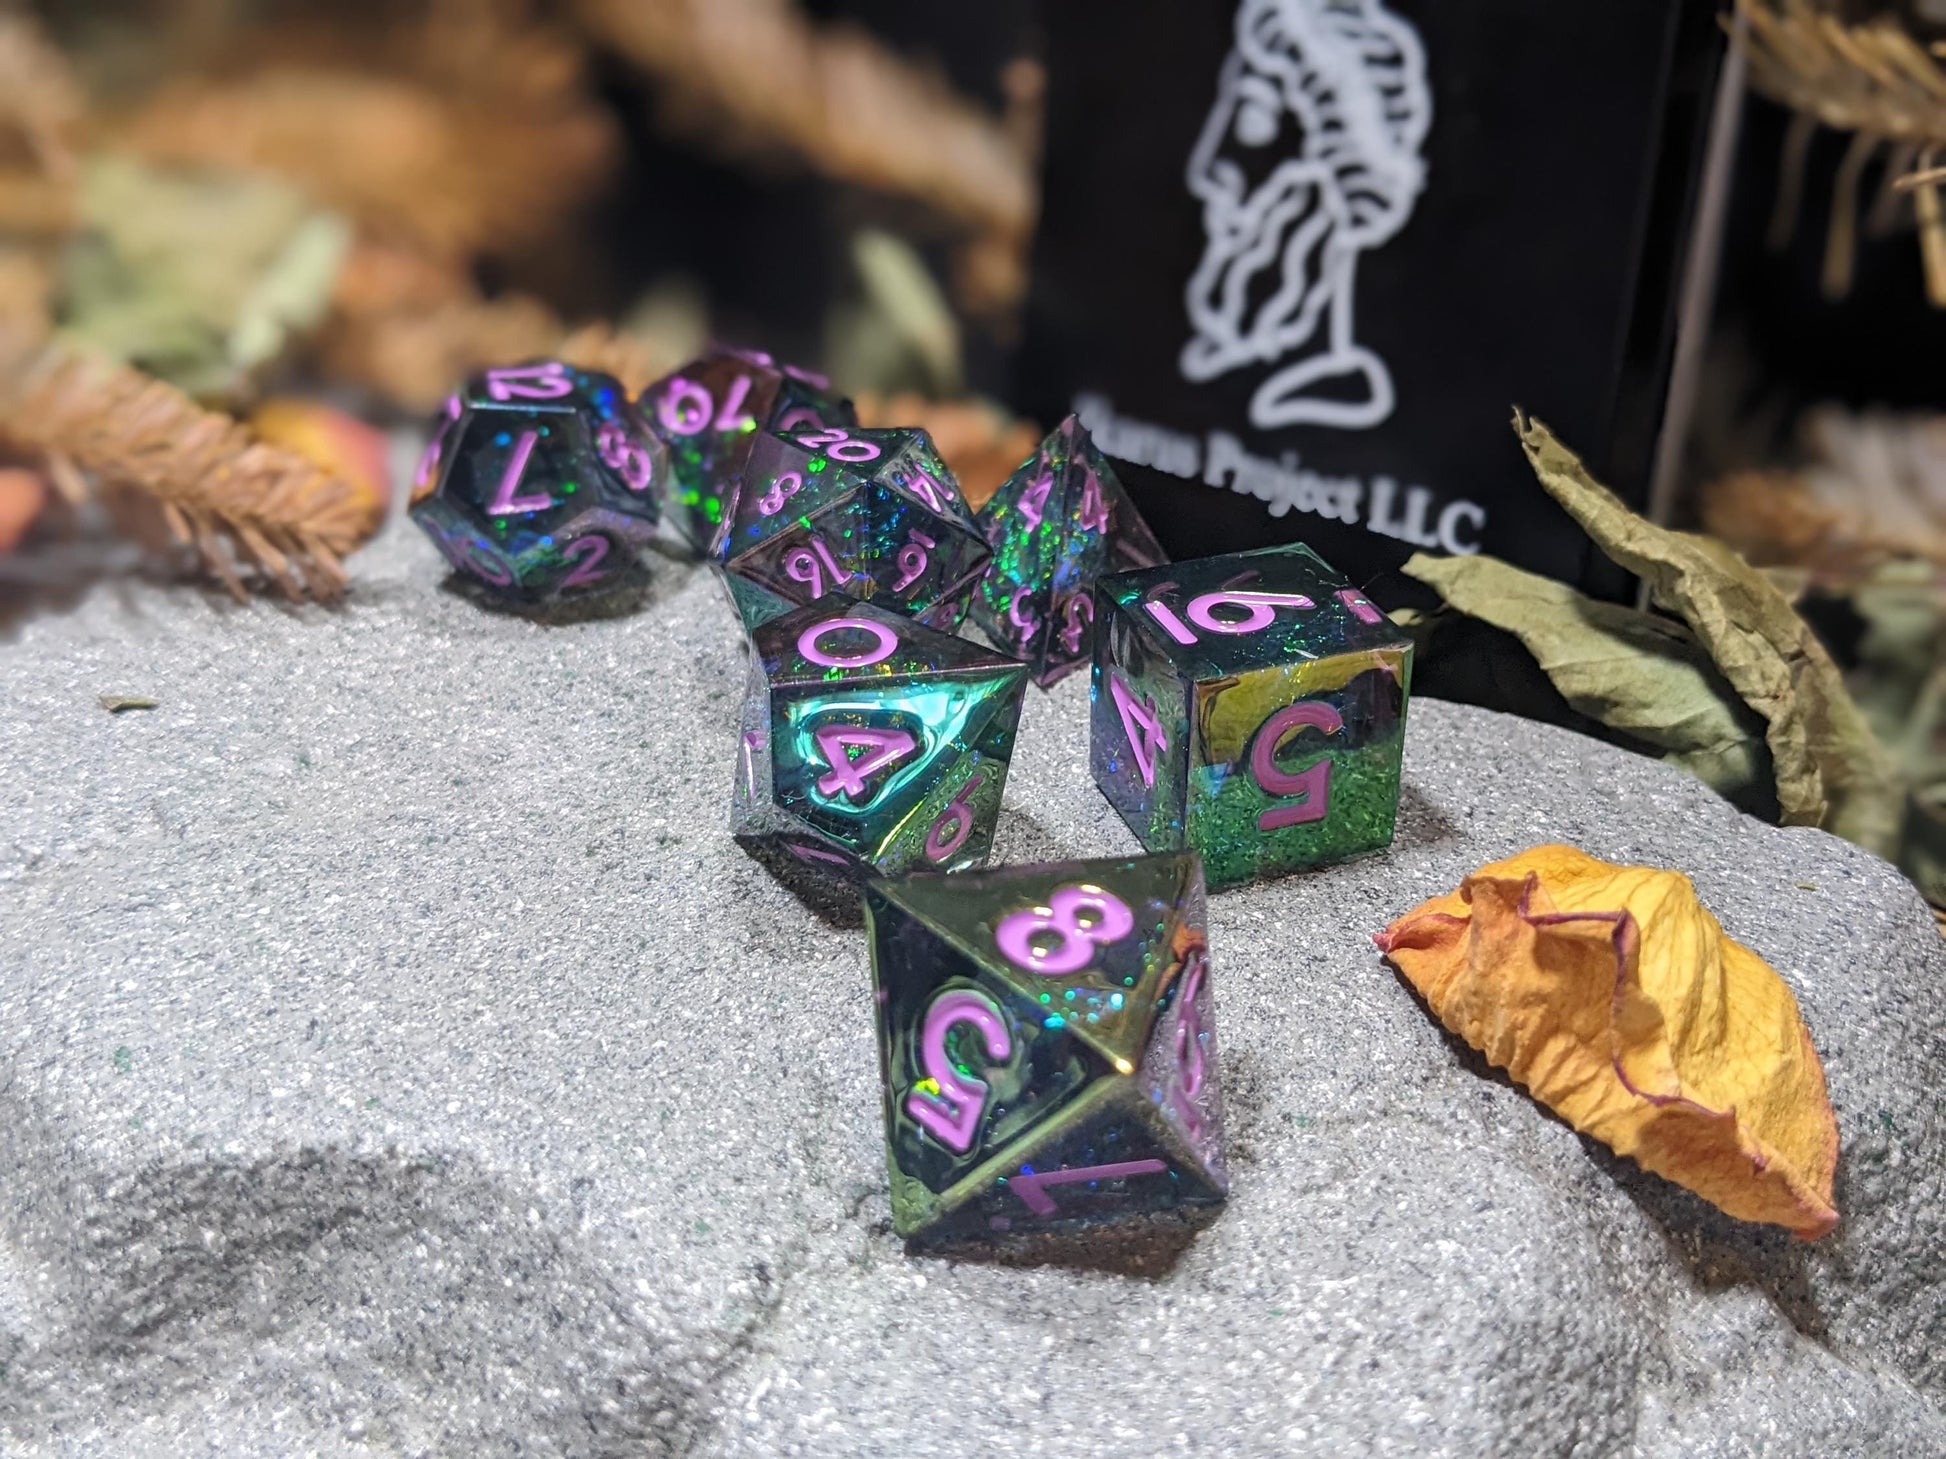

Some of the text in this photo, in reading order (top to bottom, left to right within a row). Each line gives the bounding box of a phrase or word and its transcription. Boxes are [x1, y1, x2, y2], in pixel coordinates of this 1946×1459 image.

[486, 362, 574, 401] 12
[486, 430, 551, 516] 7
[599, 421, 652, 490] 8
[796, 428, 881, 462] 20
[759, 472, 802, 516] 8
[1367, 477, 1487, 556] LLC
[797, 617, 898, 668] 0
[816, 724, 916, 797] 4
[1110, 671, 1167, 788] 4
[1252, 701, 1343, 831] 5
[995, 882, 1134, 975] 8
[907, 989, 1011, 1152] 5
